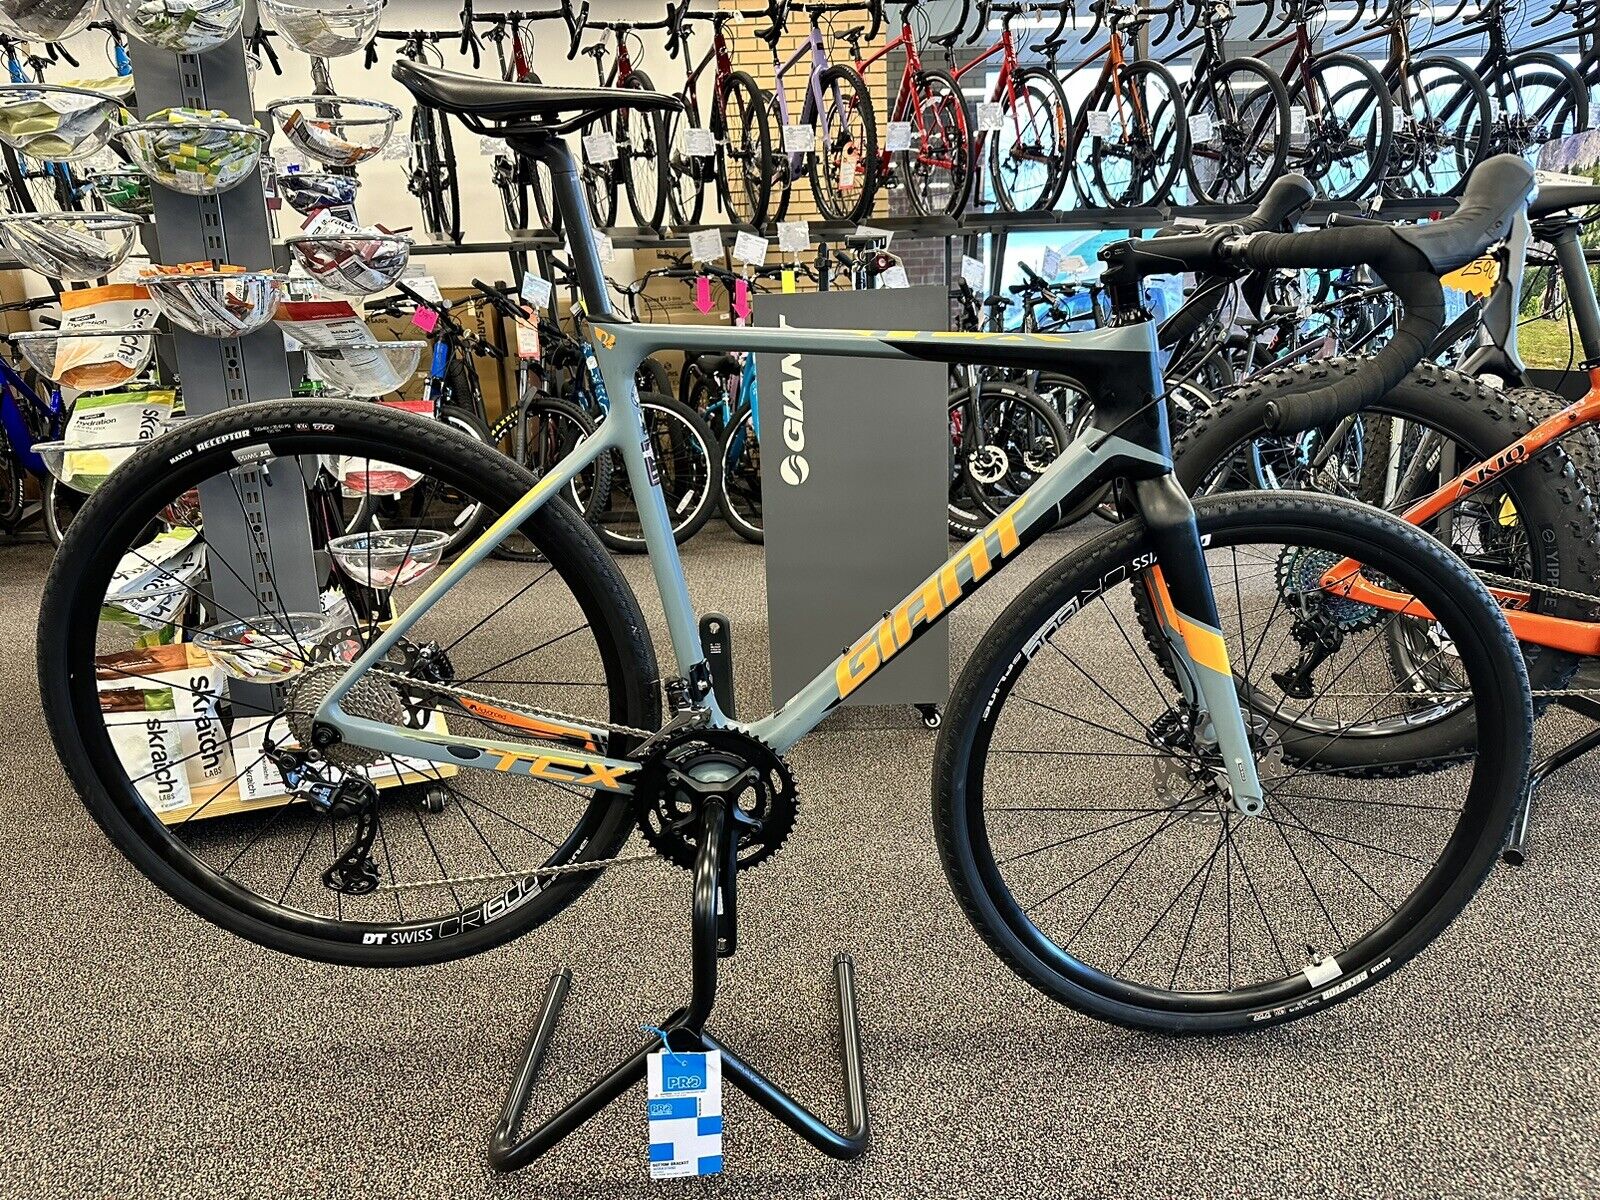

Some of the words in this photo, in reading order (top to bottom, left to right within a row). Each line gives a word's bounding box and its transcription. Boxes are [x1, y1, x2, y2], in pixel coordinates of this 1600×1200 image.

[76, 417, 117, 426] hydration
[169, 449, 193, 465] MAXXIS
[196, 429, 250, 452] RECEPTOR
[238, 452, 259, 462] SWISS
[1132, 552, 1158, 571] ISS
[835, 491, 1032, 700] GIANT
[190, 675, 224, 770] skratch
[146, 718, 178, 794] skratch
[485, 748, 635, 789] TCX
[205, 766, 222, 778] LABS
[159, 792, 175, 801] LABS
[362, 933, 387, 945] DT
[390, 928, 433, 945] SWISS
[439, 909, 481, 939] CR
[483, 875, 540, 922] 1600
[543, 836, 589, 890] spine
[1321, 970, 1368, 1001] RECEPTOR
[668, 1075, 701, 1089] PRO
[651, 1103, 672, 1112] PRO
